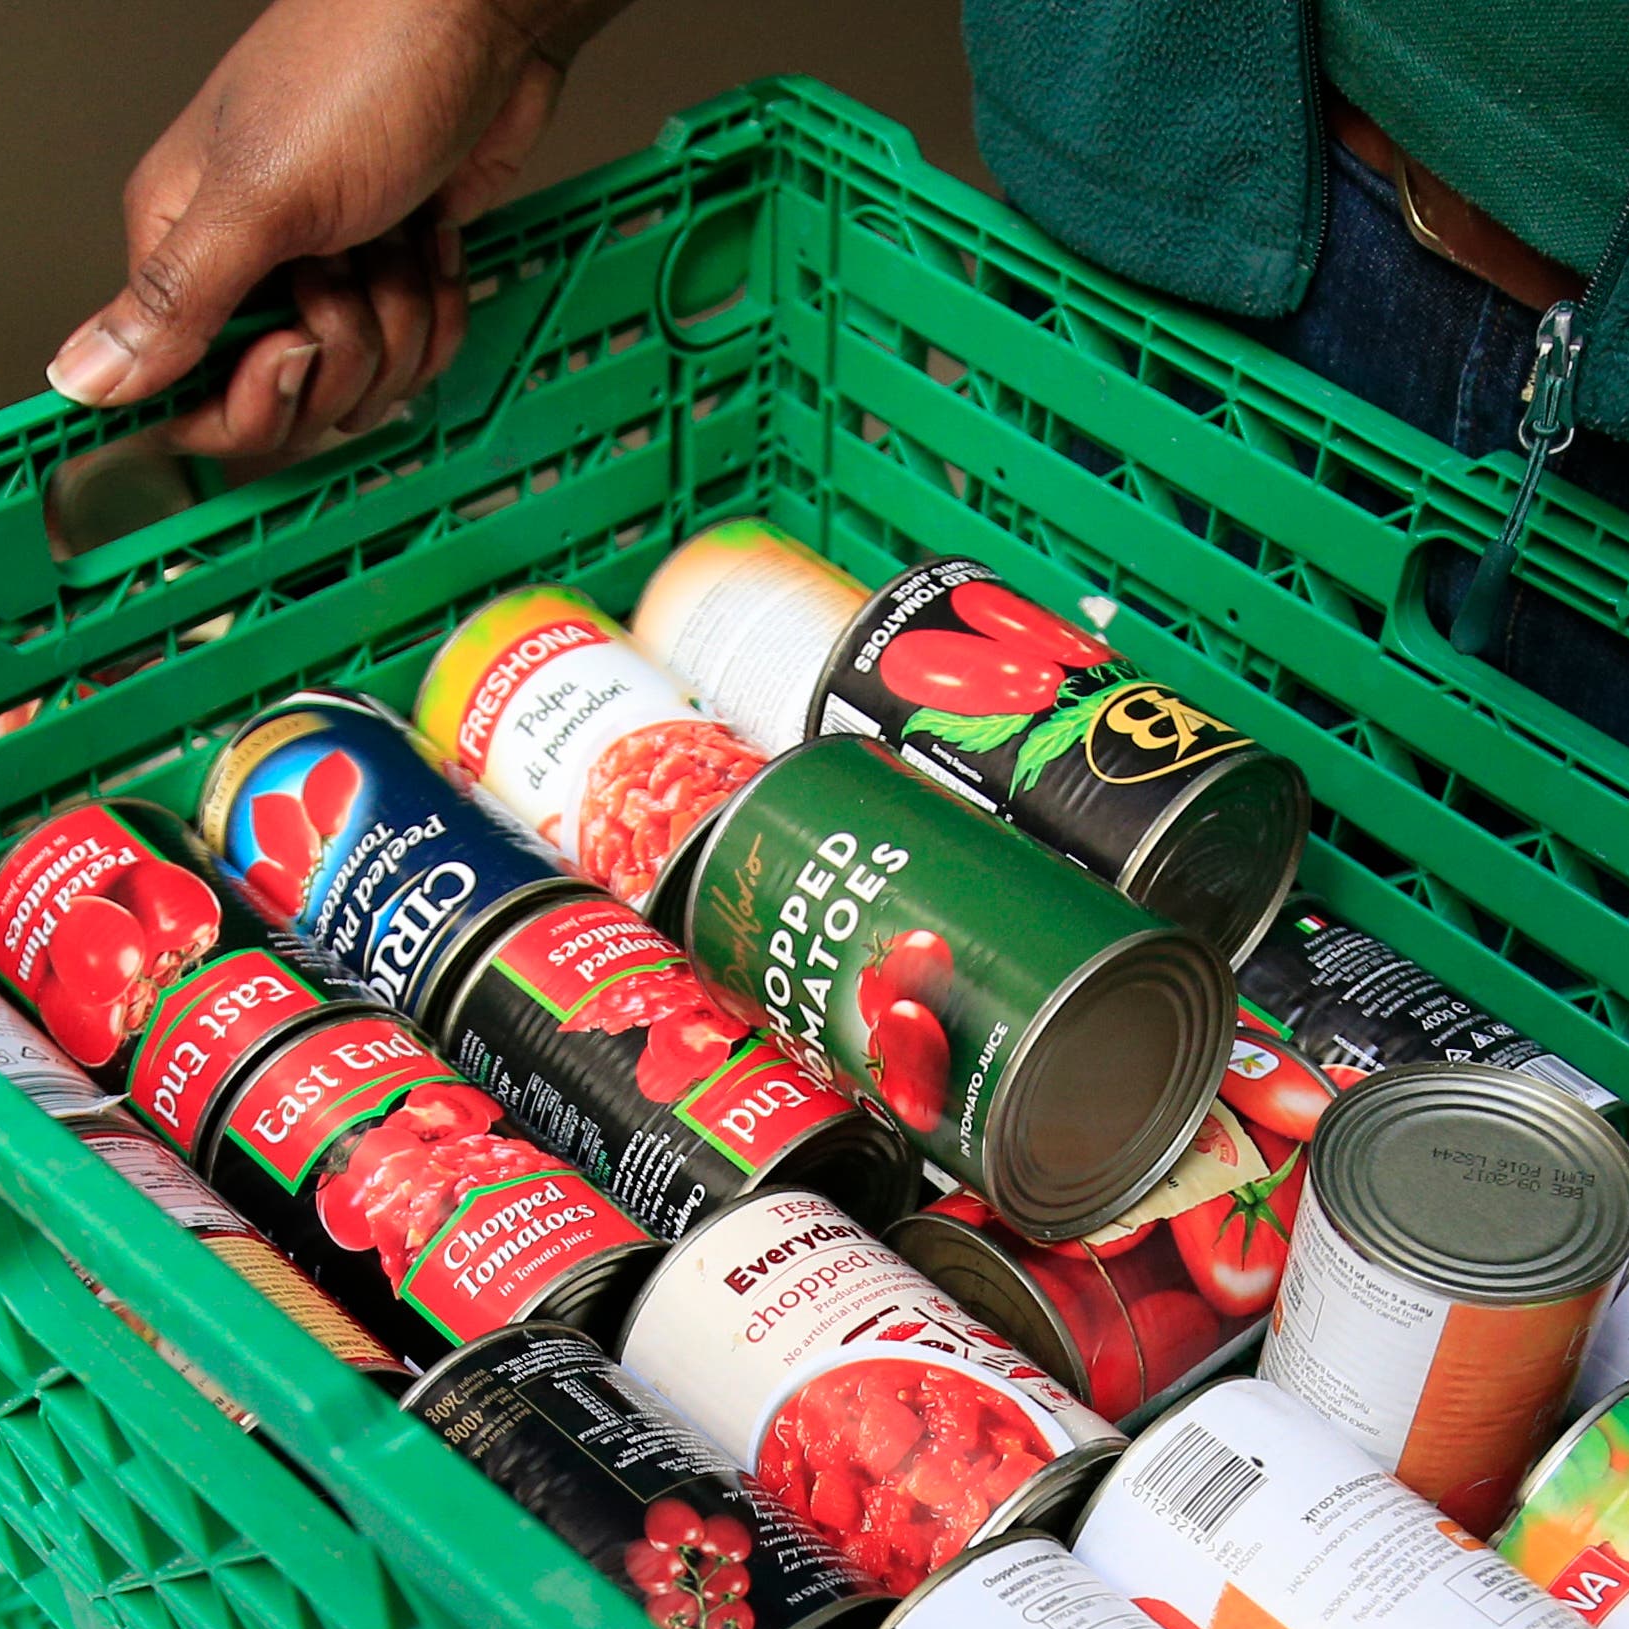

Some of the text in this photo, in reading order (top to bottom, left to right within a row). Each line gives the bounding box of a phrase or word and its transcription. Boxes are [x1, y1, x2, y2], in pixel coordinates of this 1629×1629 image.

[889, 571, 930, 601] JUICE
[853, 583, 944, 673] TOMATOES
[459, 621, 594, 759] FRESHONA
[514, 679, 578, 739] Polpa
[524, 766, 548, 791] di
[3, 836, 109, 950] Tomatoes
[312, 821, 393, 943] Tomatoes
[349, 812, 446, 912] Peeled
[15, 845, 138, 981] Peeled Plum
[152, 975, 296, 1128] East End
[1420, 1007, 1456, 1031] 400g
[251, 1064, 341, 1144] East
[332, 1031, 423, 1077] End
[719, 1079, 812, 1145] End
[962, 1066, 986, 1134] TOMATO
[979, 1021, 1009, 1065] JUICE
[441, 1180, 567, 1275] Chopped
[454, 1202, 598, 1300] Tomatoes
[514, 1241, 565, 1284] Tomato
[560, 1227, 596, 1255] Juice
[722, 1222, 862, 1295] Everyday
[746, 1248, 872, 1345] chopped
[801, 1303, 852, 1348] artificial
[812, 1276, 871, 1314] Produced
[423, 1388, 466, 1425] 260g
[441, 1404, 488, 1448] 400g
[1129, 1481, 1206, 1547] 0112 5214
